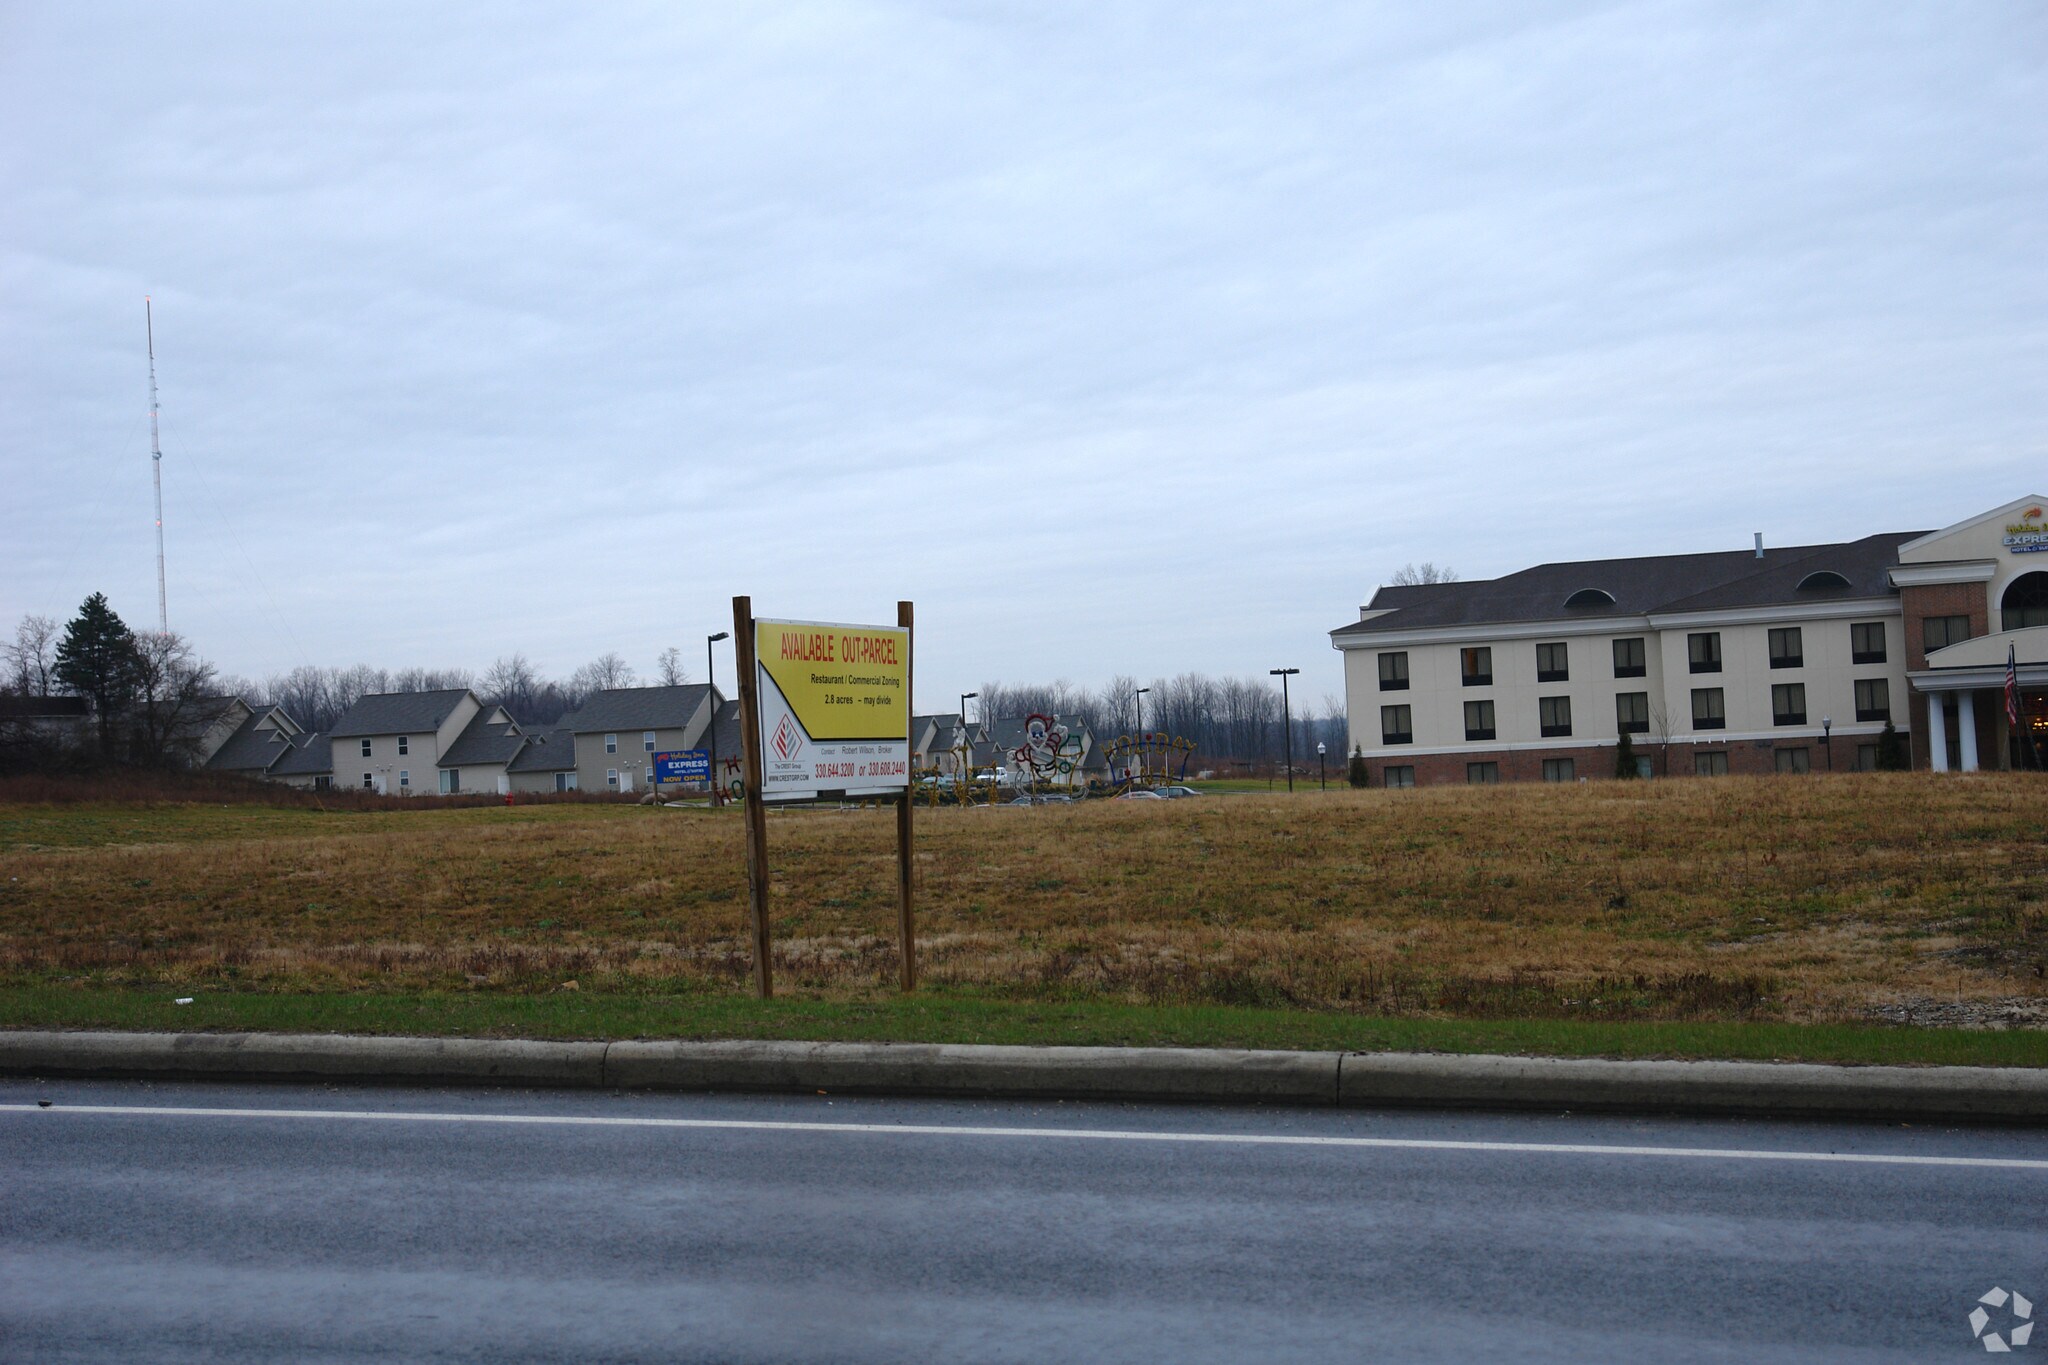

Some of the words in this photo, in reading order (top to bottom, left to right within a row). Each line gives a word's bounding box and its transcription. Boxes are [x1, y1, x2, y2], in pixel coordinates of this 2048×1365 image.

[2003, 535, 2048, 546] EXPRE
[781, 633, 834, 662] AVAILABLE
[842, 636, 898, 665] OUT-PARCEL
[811, 673, 844, 684] Restaurant
[848, 674, 881, 685] Commercial
[882, 675, 900, 688] Zoning
[825, 694, 835, 704] 2.8
[836, 696, 853, 704] acres
[864, 696, 875, 707] may
[876, 695, 892, 705] divide
[670, 752, 692, 760] Holiday
[842, 746, 858, 755] Robert
[878, 746, 893, 754] Broker
[668, 760, 709, 769] EXPRESS
[815, 763, 854, 778] 330.644.3200
[859, 766, 866, 776] or
[868, 761, 906, 777] 330.608.2440
